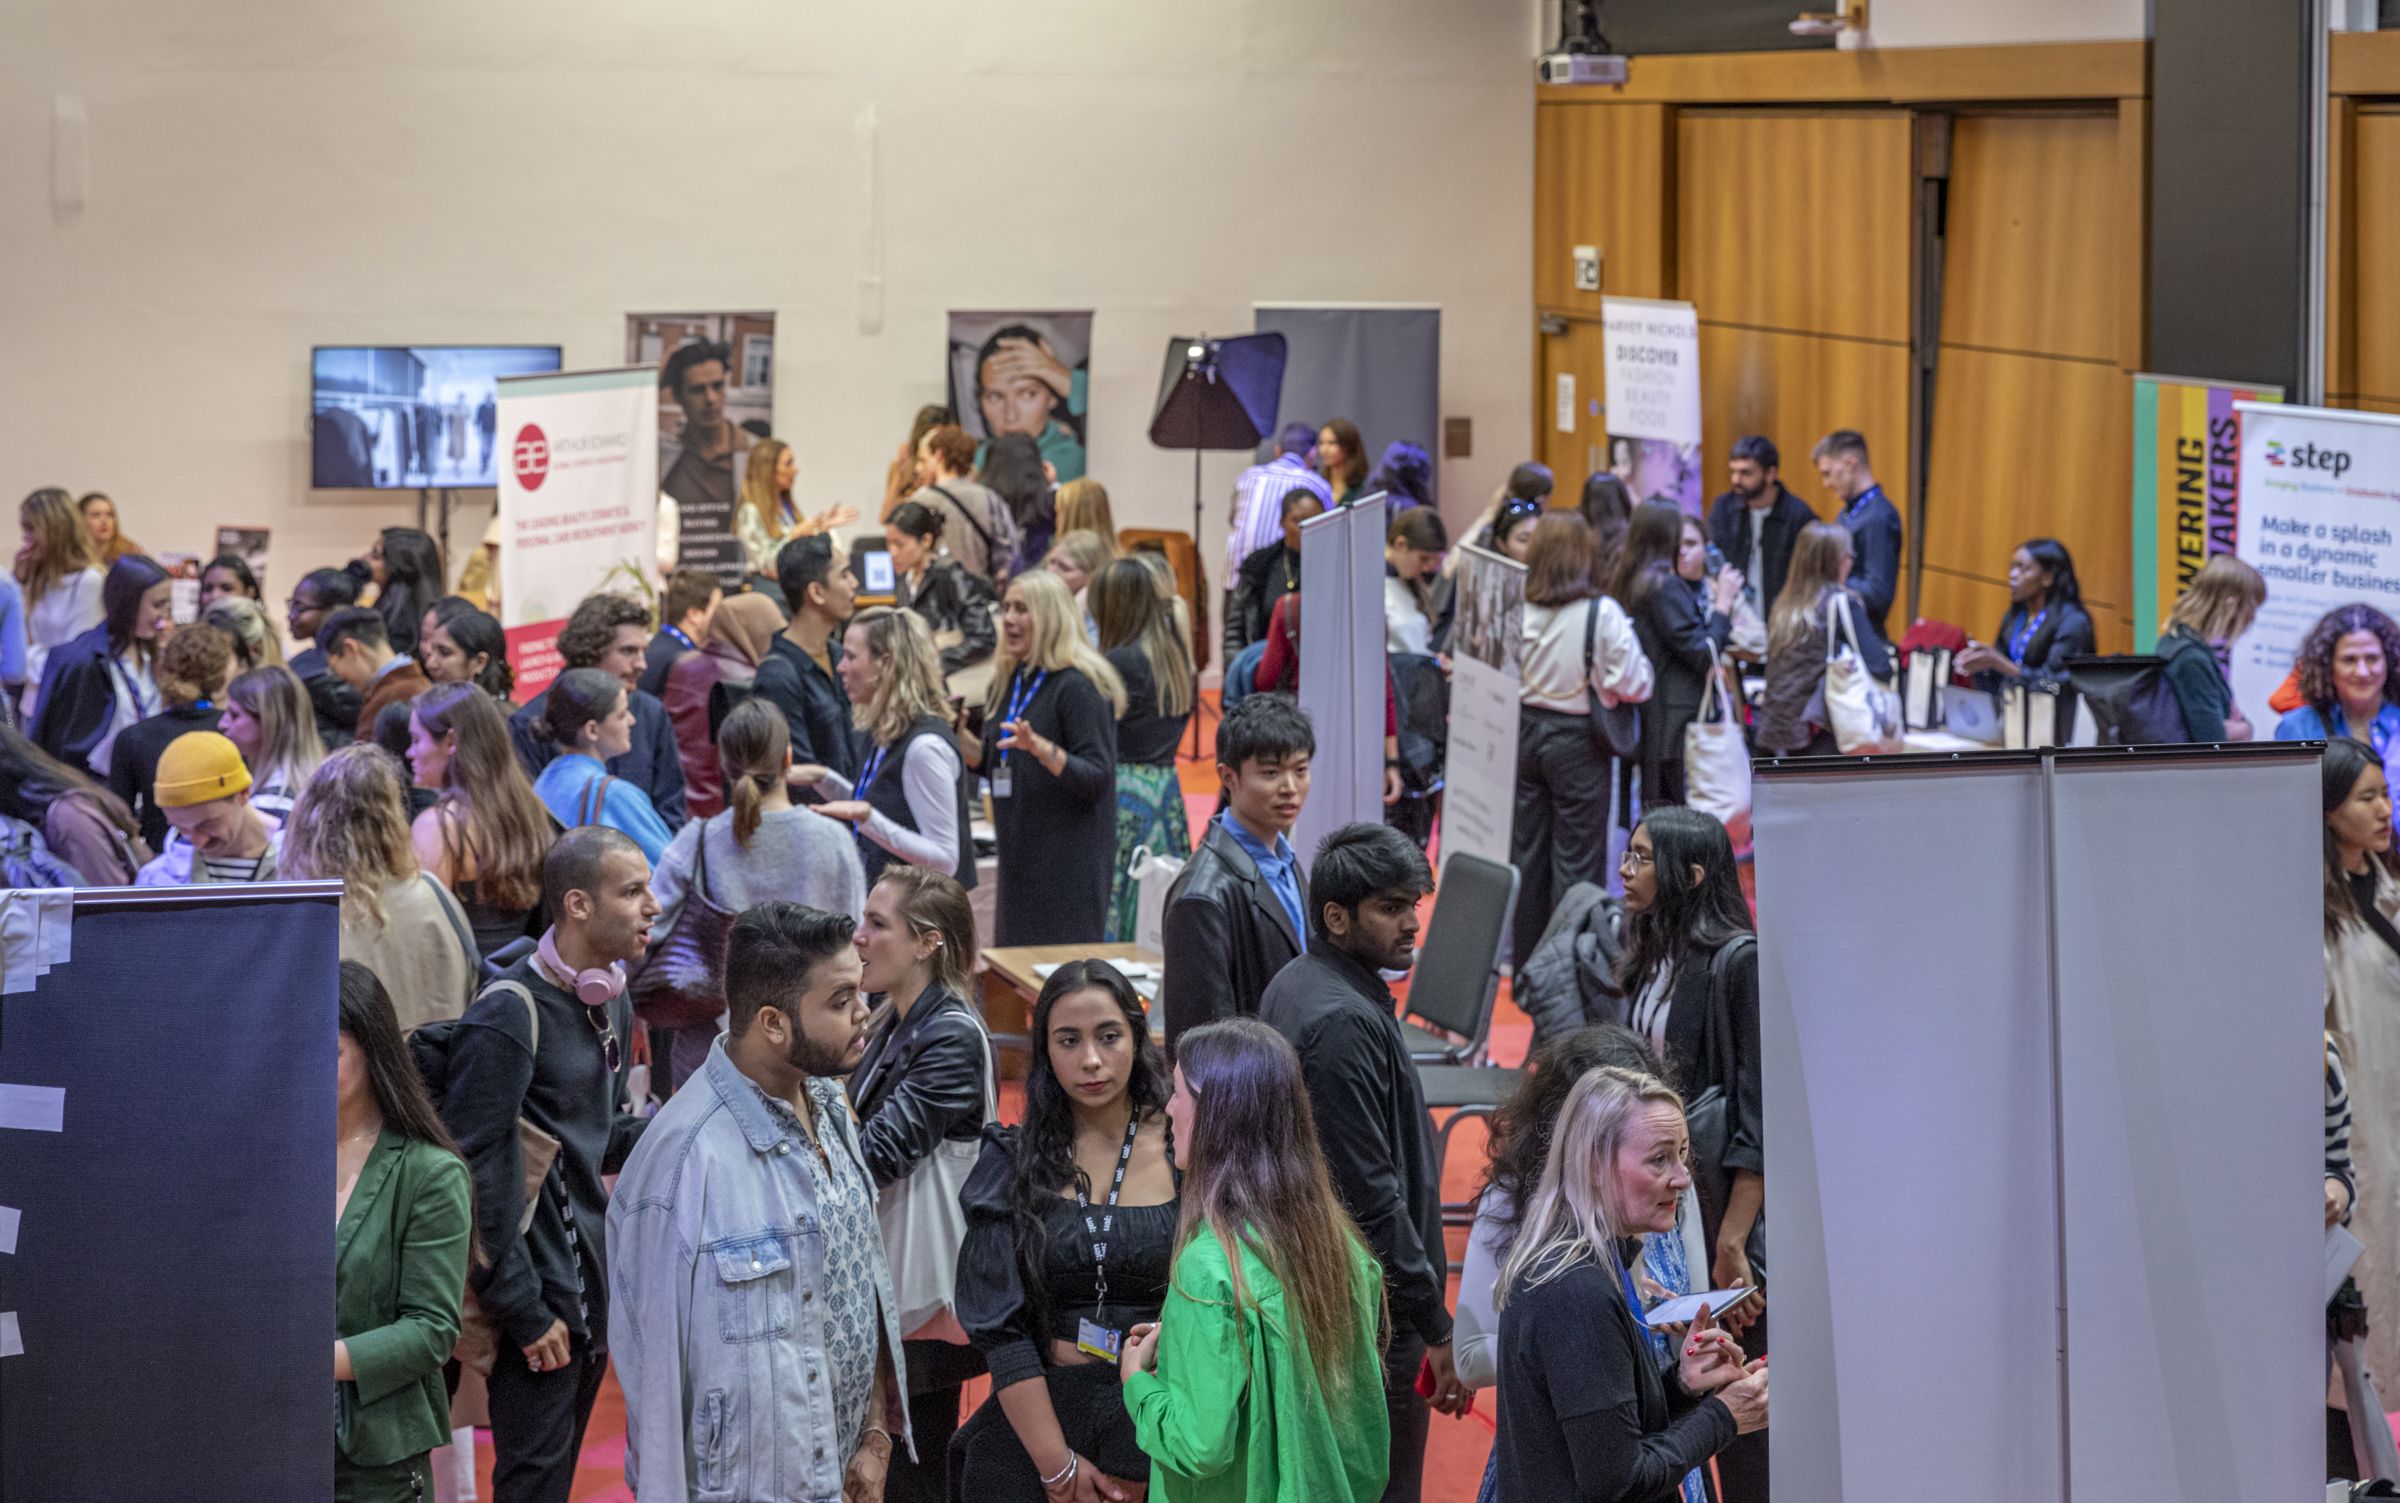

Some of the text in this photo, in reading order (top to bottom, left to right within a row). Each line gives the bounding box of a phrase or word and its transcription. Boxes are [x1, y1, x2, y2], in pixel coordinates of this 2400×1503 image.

[1616, 344, 1679, 366] DISCOVER
[1620, 366, 1676, 386] FASHION
[2291, 440, 2350, 479] step
[2210, 416, 2237, 560] AKERS
[2260, 514, 2393, 547] Make a splash
[2258, 536, 2380, 569] in a dynamic
[2257, 562, 2327, 585] smaller
[1115, 1167, 1125, 1183] ual:
[1109, 1191, 1119, 1206] ual:
